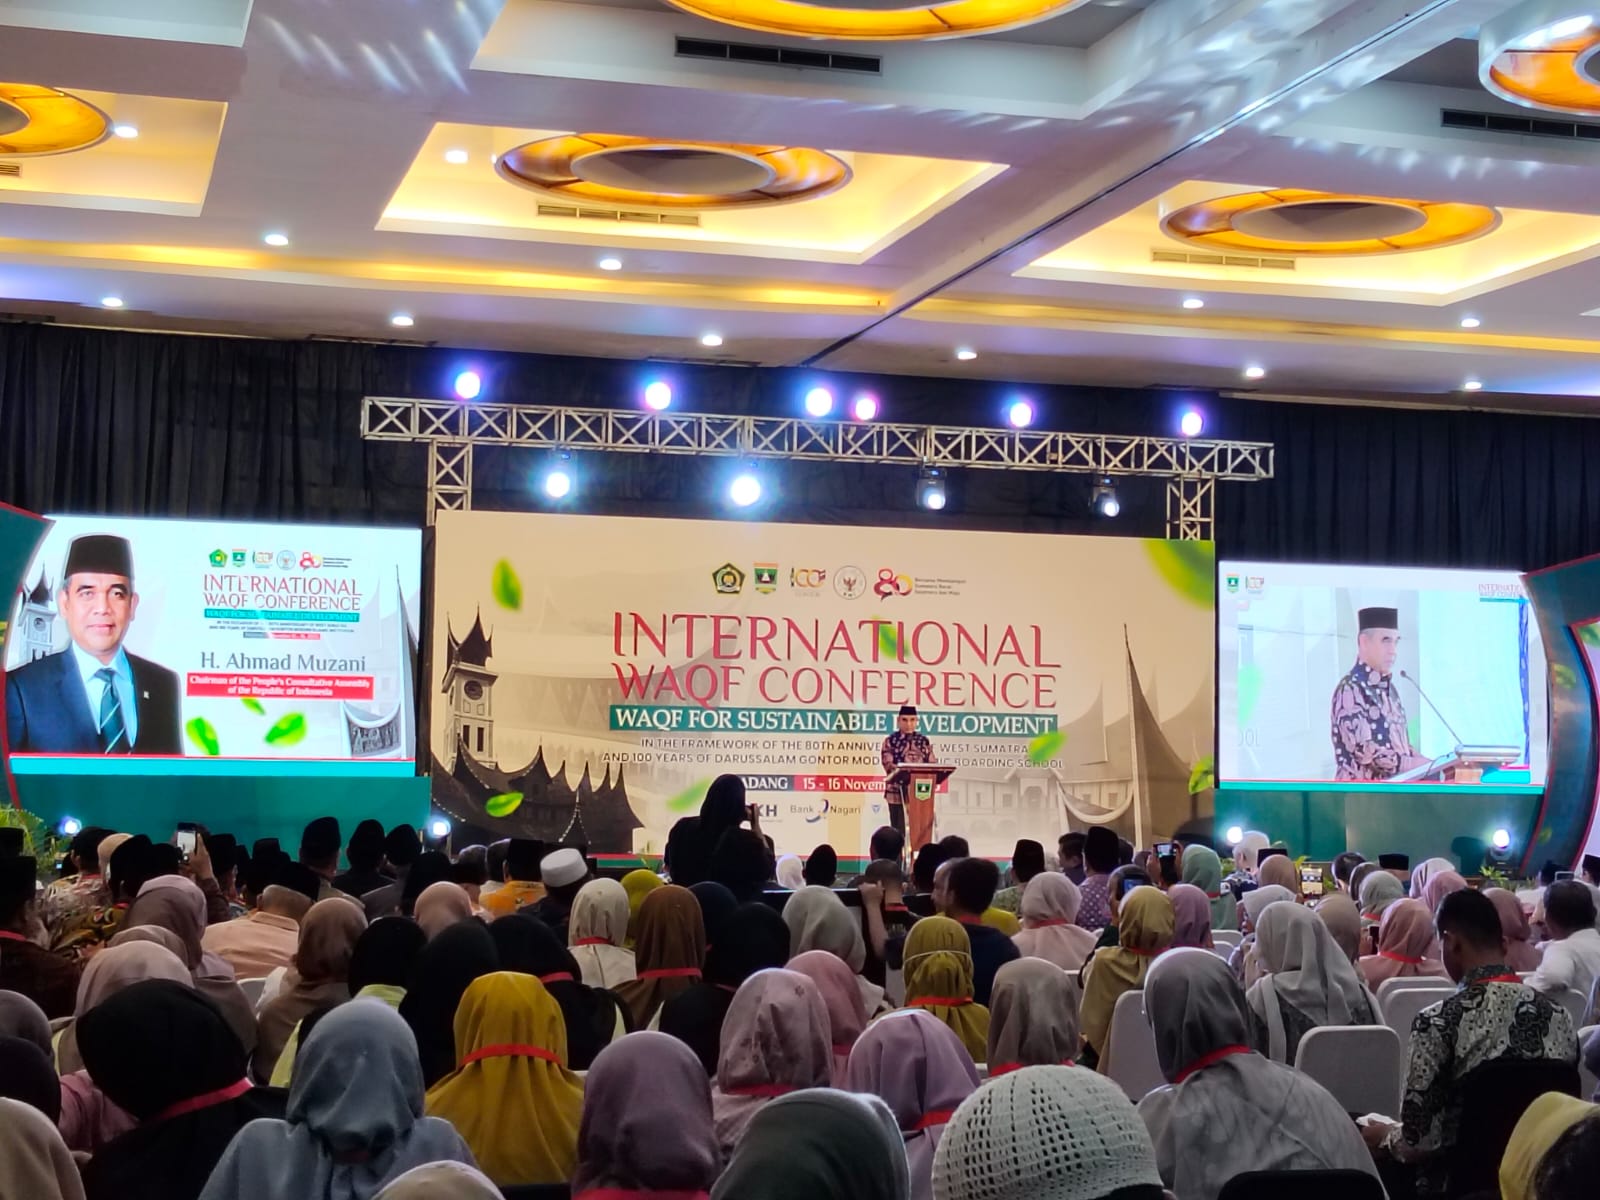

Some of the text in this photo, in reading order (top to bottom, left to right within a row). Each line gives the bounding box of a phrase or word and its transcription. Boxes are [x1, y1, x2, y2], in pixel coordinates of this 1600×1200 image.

[203, 574, 362, 596] INTERNATIONAL
[203, 593, 361, 611] WAQF CONFERENCE
[613, 611, 1062, 668] INTERNATIONAL
[201, 652, 366, 672] H. Ahmad Muzani
[228, 676, 238, 685] of
[238, 676, 252, 685] the
[611, 662, 1057, 710] WAQF CONFERENCE
[615, 708, 683, 731] WAQF
[688, 709, 732, 729] FOR
[737, 709, 887, 731] SUSTAINABLE
[641, 738, 653, 748] IN
[658, 738, 678, 748] THE
[681, 739, 759, 749] FRAMEWORK
[763, 740, 777, 750] OF
[781, 740, 803, 750] THE
[837, 741, 881, 751] ANNIVE
[940, 743, 970, 753] WEST
[974, 744, 1028, 754] SUMATRA
[603, 752, 630, 762] AND
[632, 752, 652, 763] 100
[656, 753, 693, 763] YEARS
[696, 753, 711, 763] OF
[714, 753, 796, 764] DARUSSALAM
[799, 755, 849, 765] GONTOR
[957, 758, 1014, 768] BOARDING
[802, 777, 815, 790] 15
[828, 777, 840, 790] 16
[844, 778, 886, 790] Novem
[790, 804, 814, 813] Bank
[830, 805, 861, 815] Nagari
